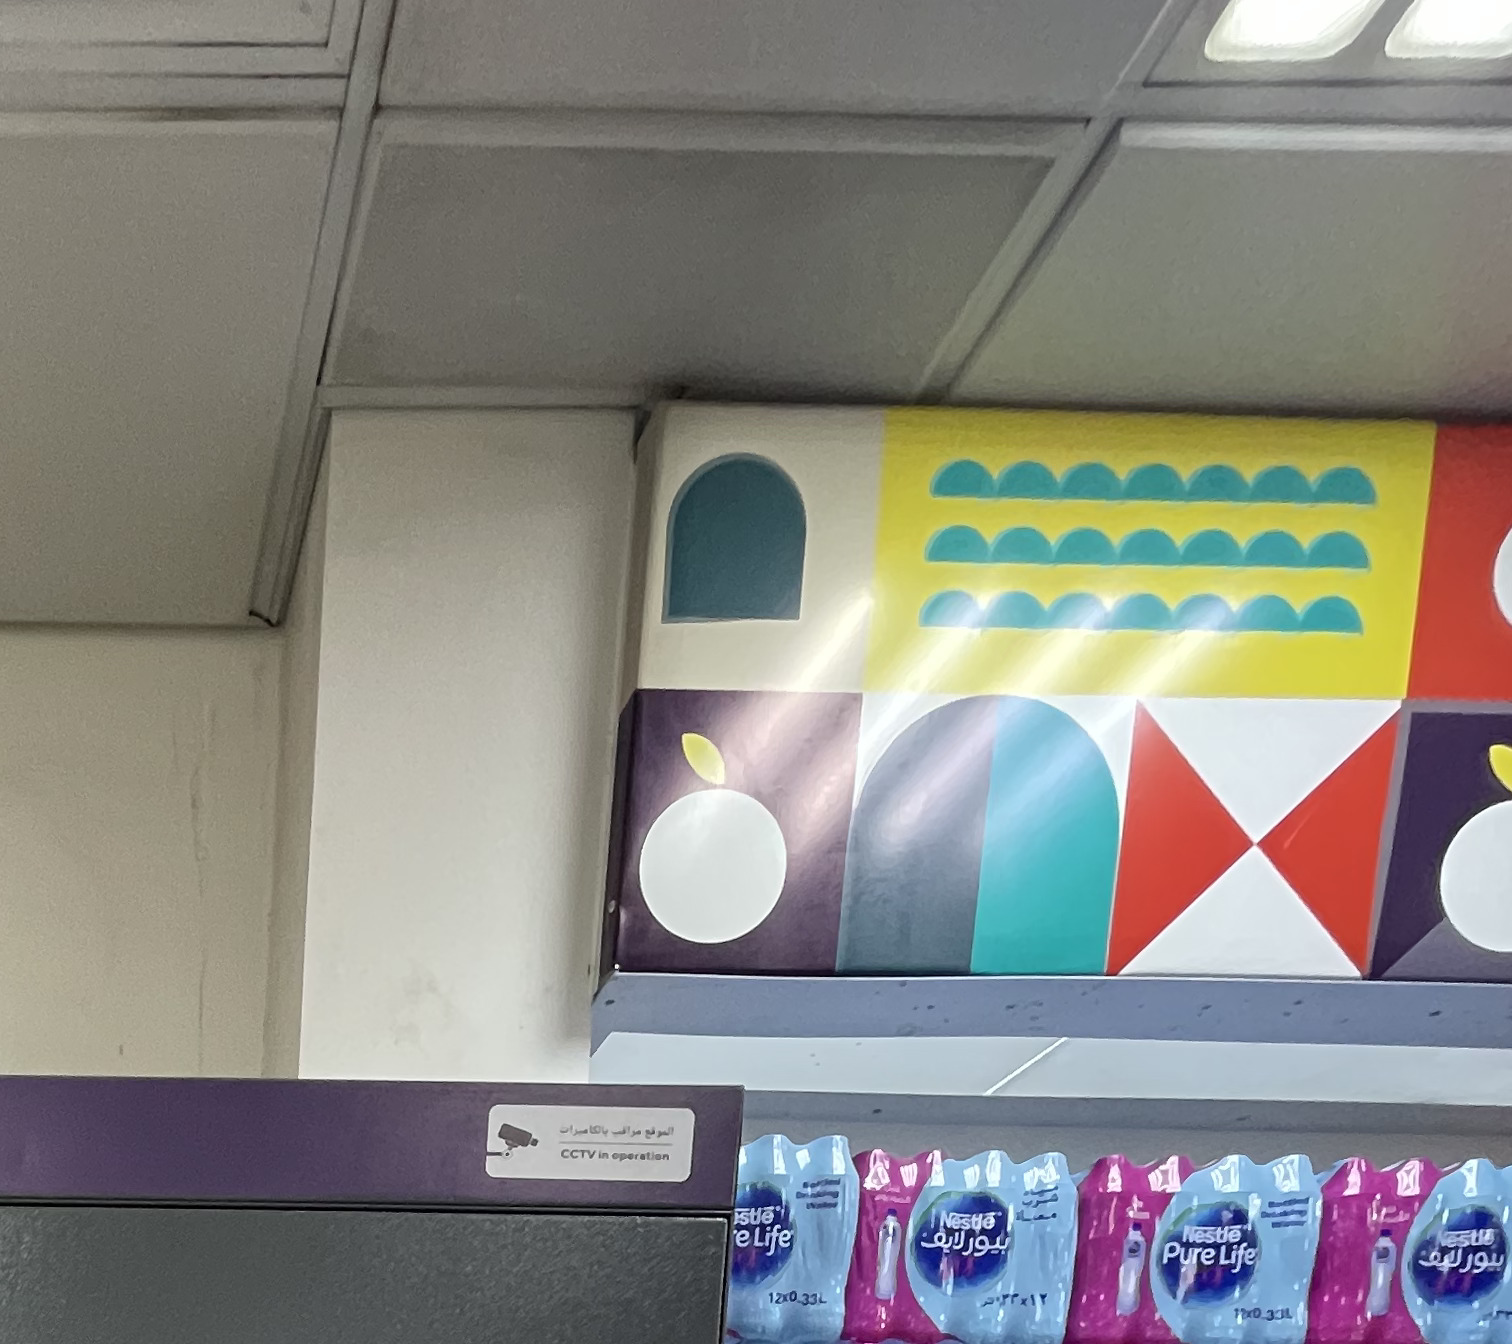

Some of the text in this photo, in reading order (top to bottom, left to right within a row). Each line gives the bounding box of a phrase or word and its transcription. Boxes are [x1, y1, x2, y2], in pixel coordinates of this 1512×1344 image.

[560, 1149, 670, 1161] CCTV in operation
[753, 1225, 792, 1256] Life
[1162, 1242, 1257, 1274] Pure Life
